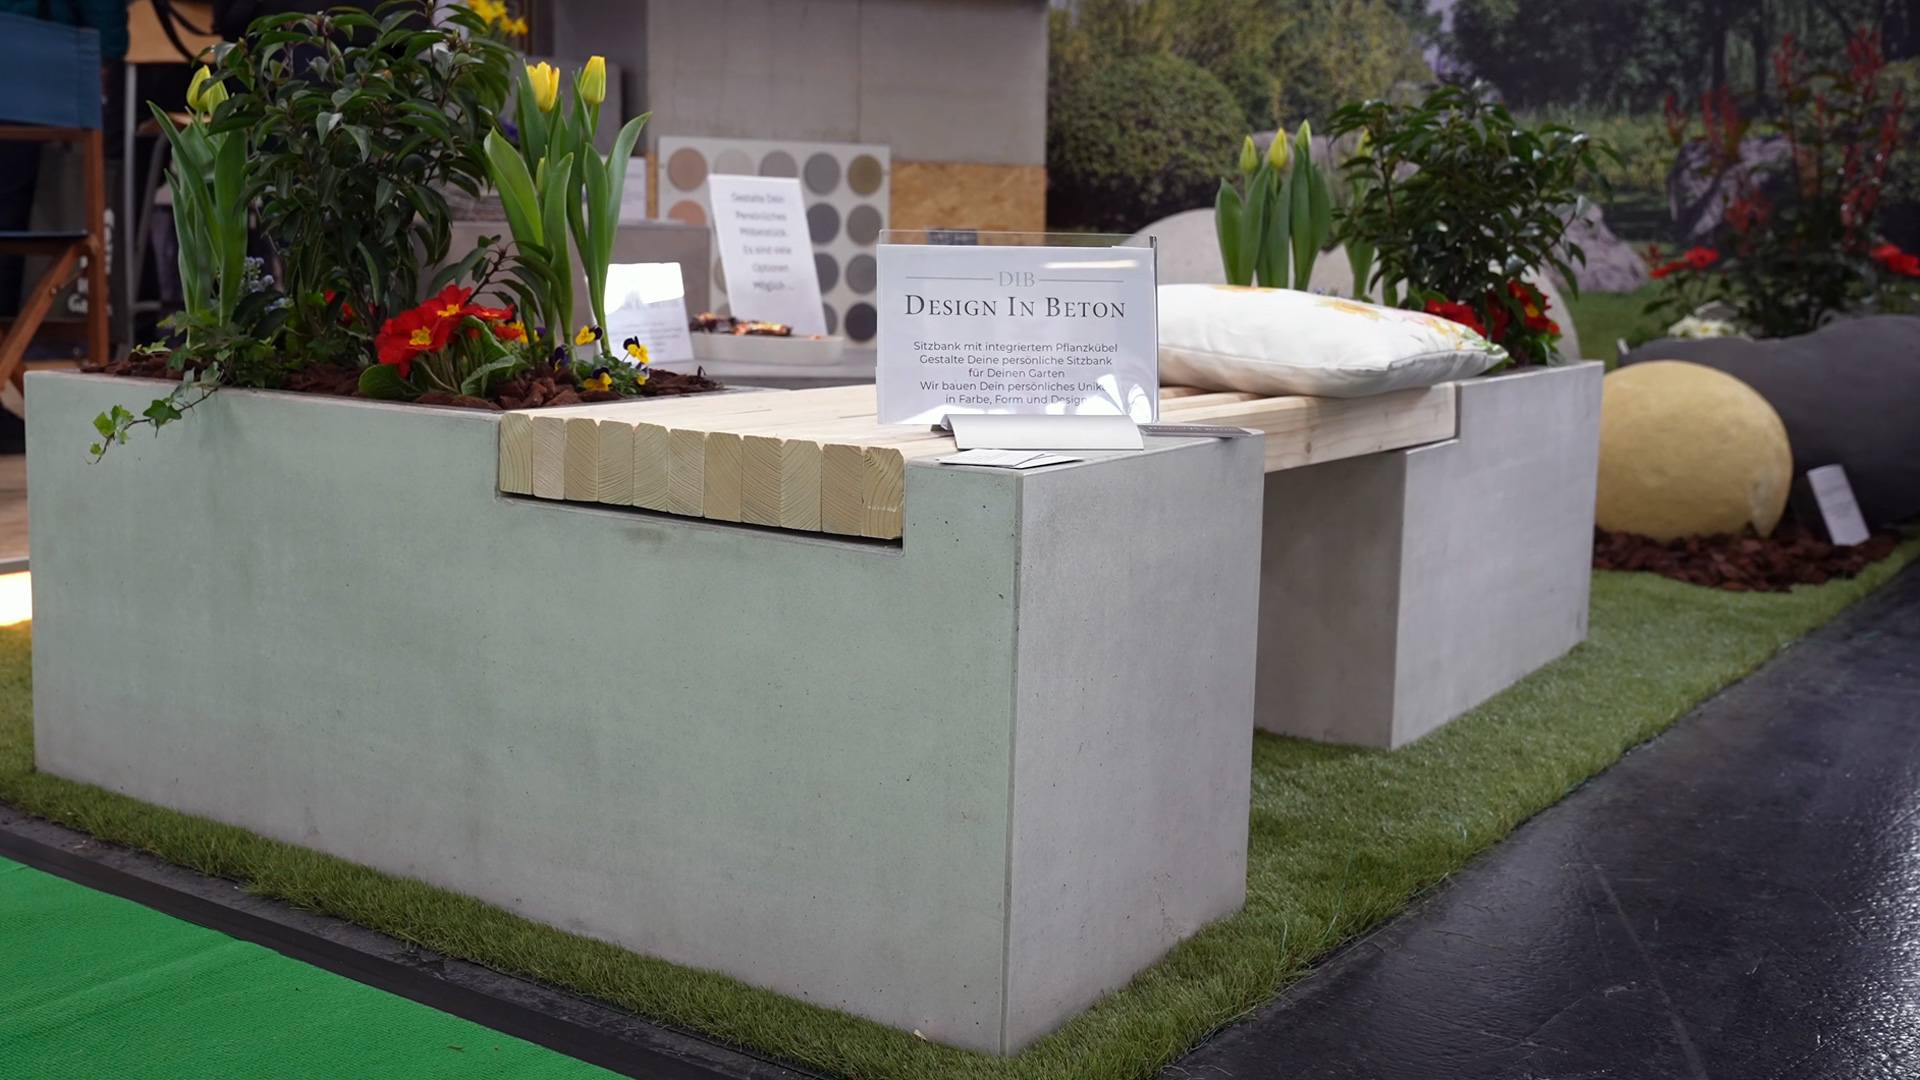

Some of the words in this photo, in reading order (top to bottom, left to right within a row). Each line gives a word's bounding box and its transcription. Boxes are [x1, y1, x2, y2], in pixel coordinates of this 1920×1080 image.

[998, 271, 1036, 288] DIB
[904, 294, 997, 317] DESIGN
[1007, 296, 1035, 317] IN
[1045, 297, 1126, 318] BETON
[913, 341, 961, 351] Sitzbank
[964, 341, 982, 351] mit
[985, 342, 1053, 353] integriertem
[1056, 342, 1118, 353] Pflanzkübel
[919, 354, 965, 364] Gestalte
[968, 355, 999, 364] Deine
[1002, 355, 1064, 368] persönliche
[1066, 355, 1113, 366] Sitzbank
[968, 368, 984, 378] für
[987, 368, 1026, 378] Deinen
[1028, 369, 1065, 378] Garten
[920, 381, 939, 391] Wir
[942, 381, 977, 391] bauen
[980, 381, 1005, 391] Dein
[1008, 381, 1075, 394] persönliches
[1078, 381, 1107, 392] Unik
[945, 394, 956, 404] in
[959, 394, 992, 406] Farbe,
[995, 394, 1024, 404] Form
[1026, 394, 1048, 404] und
